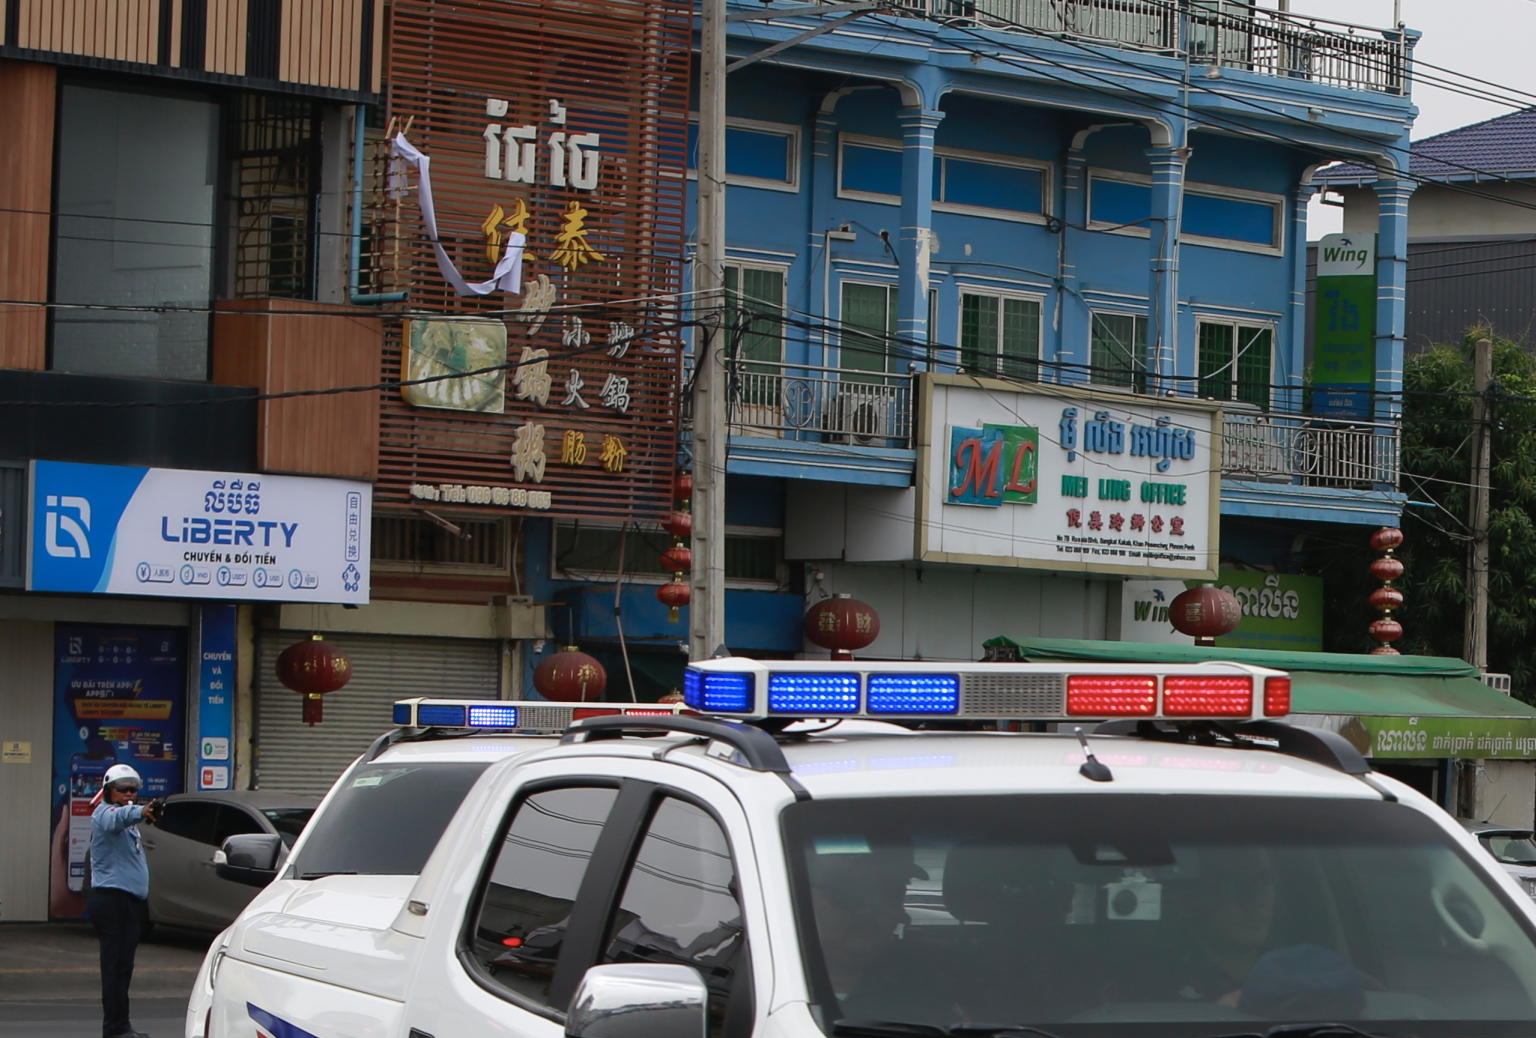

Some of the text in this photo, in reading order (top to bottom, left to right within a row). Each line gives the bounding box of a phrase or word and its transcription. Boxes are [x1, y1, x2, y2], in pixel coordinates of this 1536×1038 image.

[1323, 247, 1368, 270] Wing
[510, 488, 527, 507] 88
[1061, 475, 1187, 506] MEI LING OFFICE
[225, 553, 231, 563] &
